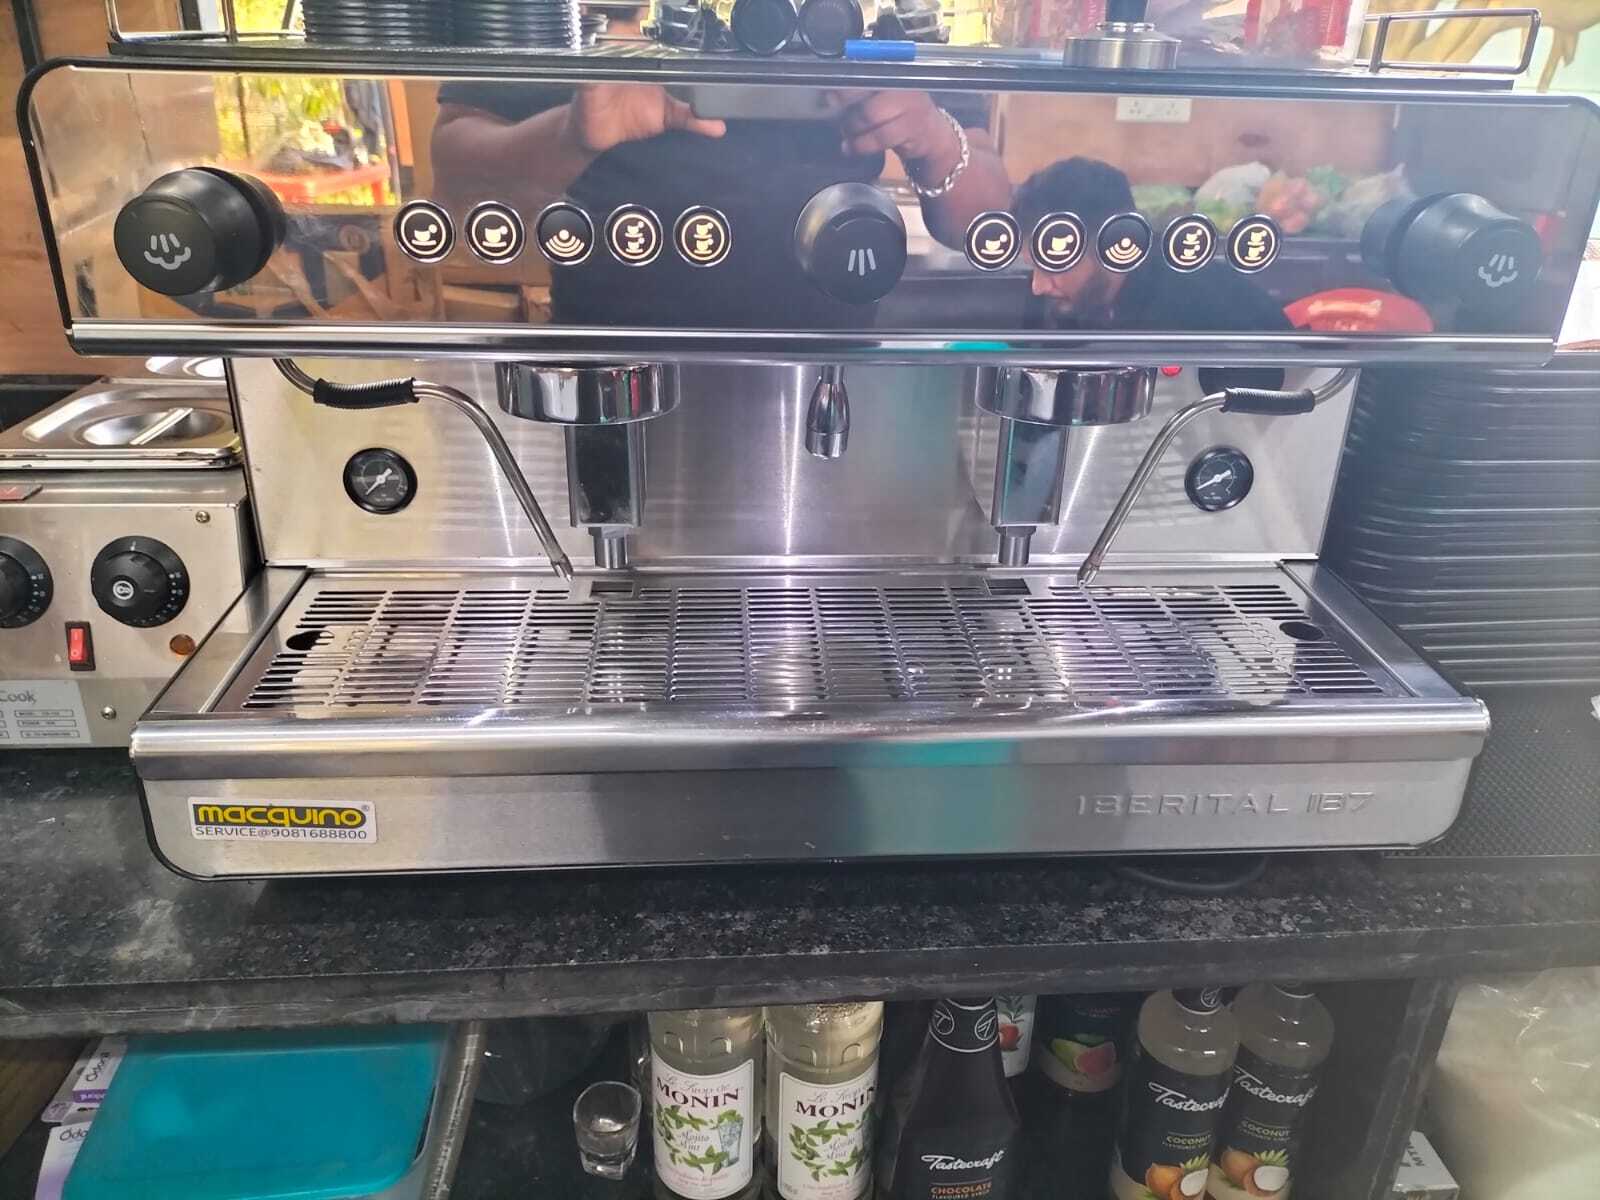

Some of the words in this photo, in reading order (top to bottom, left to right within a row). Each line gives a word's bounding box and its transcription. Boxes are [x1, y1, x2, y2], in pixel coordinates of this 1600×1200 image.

[1077, 792, 1289, 816] IBERITAL
[196, 805, 363, 828] macquino
[657, 1077, 738, 1108] MONIN
[920, 1149, 1004, 1171] Tastecraft
[931, 1182, 992, 1195] CHOCOLATE
